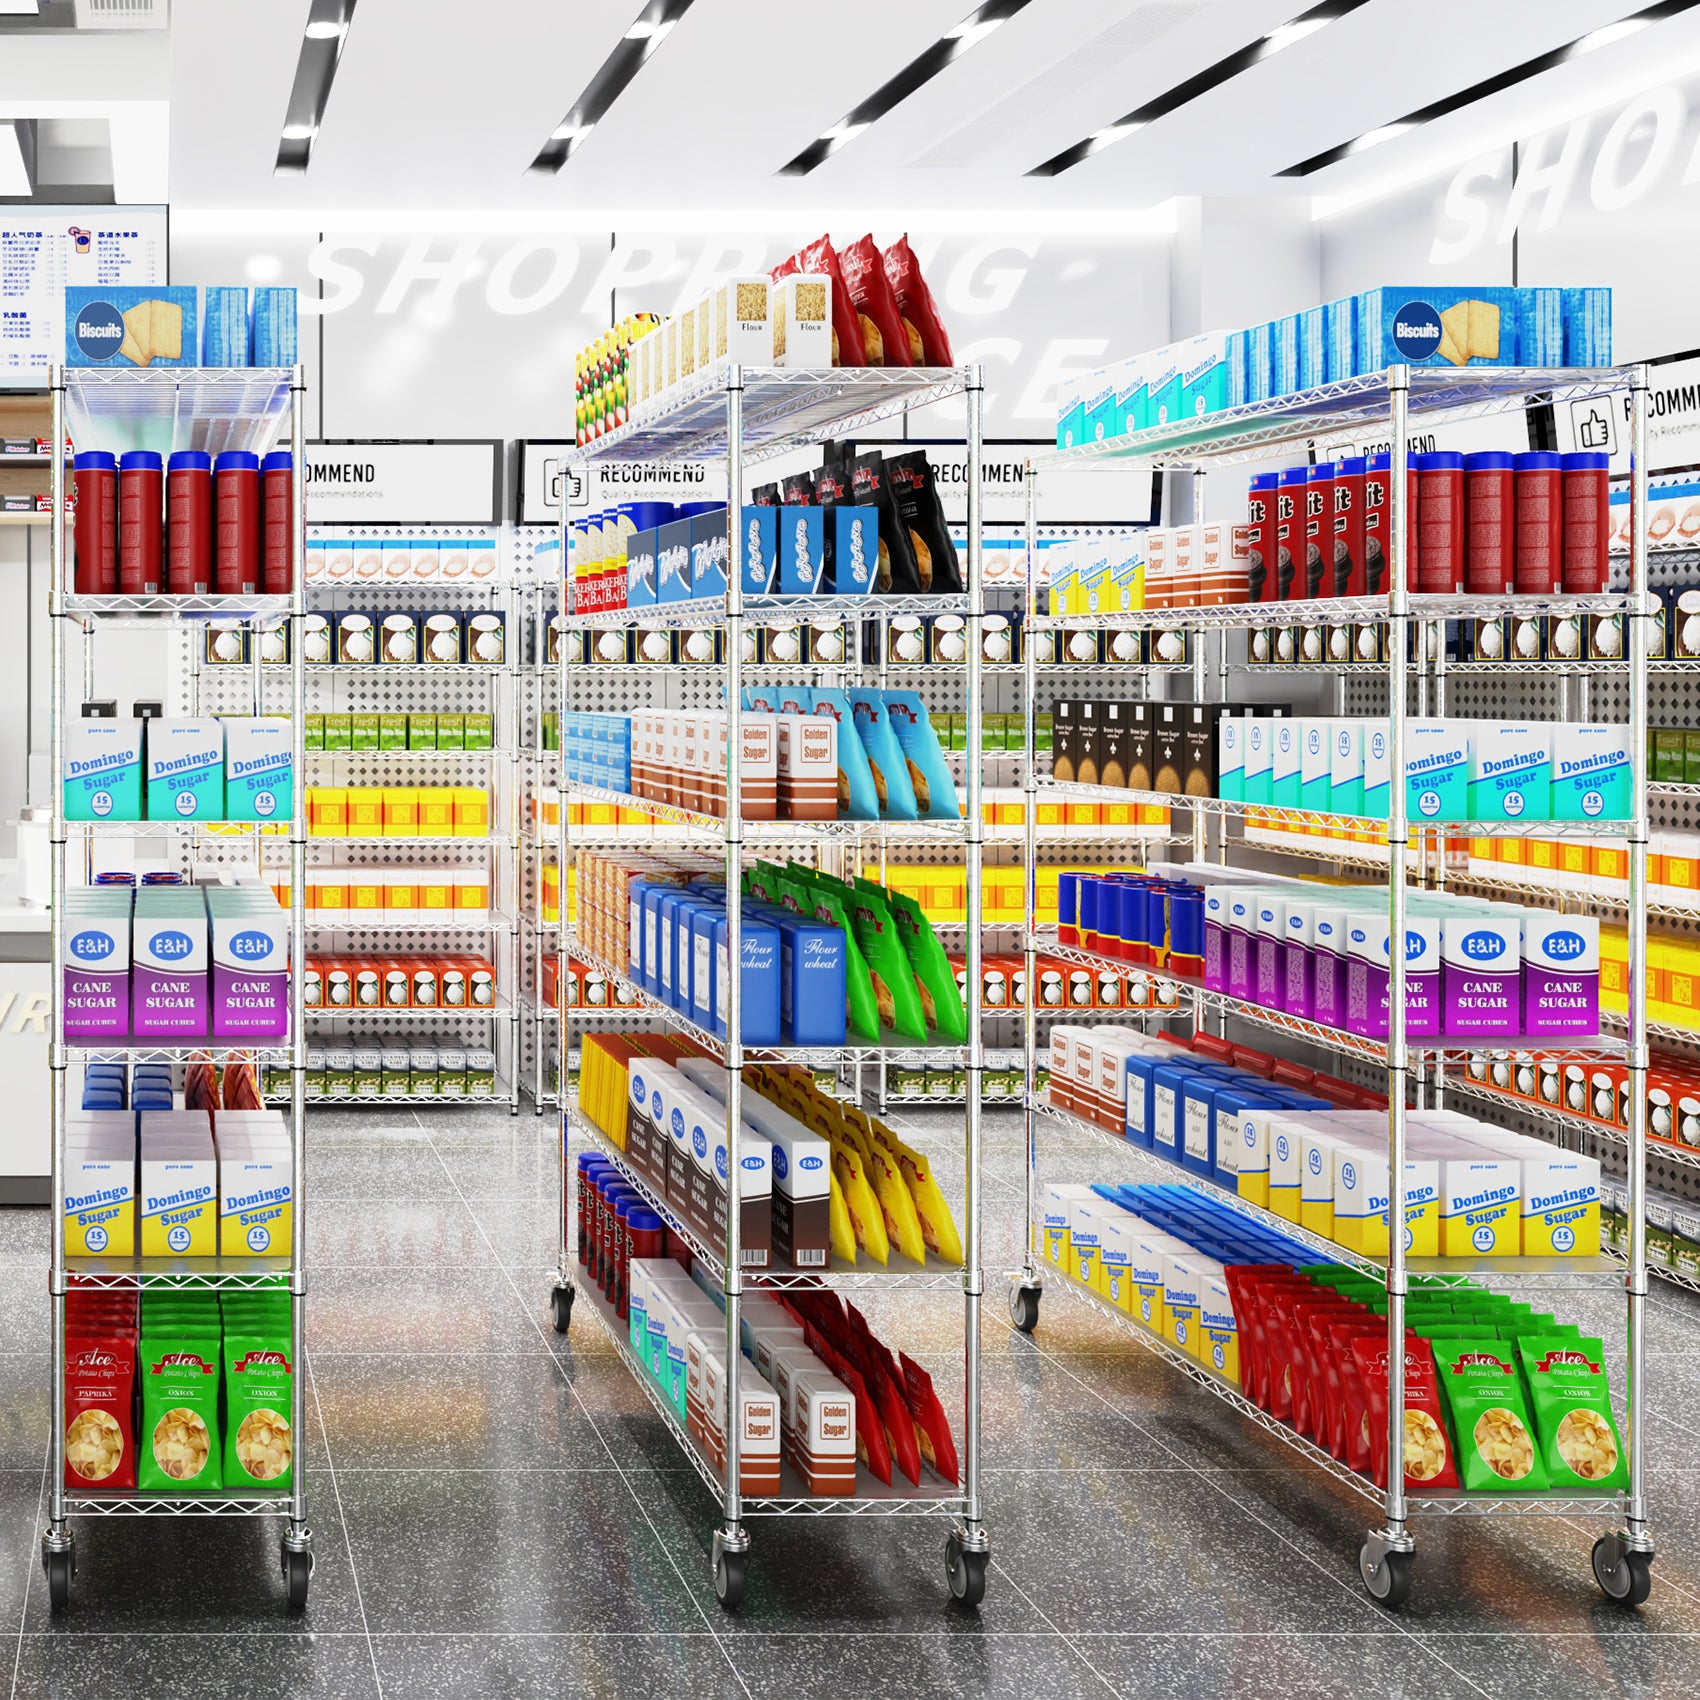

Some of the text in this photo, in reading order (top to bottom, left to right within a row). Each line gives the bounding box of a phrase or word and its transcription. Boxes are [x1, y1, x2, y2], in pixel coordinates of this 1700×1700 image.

[79, 322, 122, 338] Biscuits
[1396, 322, 1440, 338] Biscuits
[1185, 354, 1216, 382] Domingo
[1150, 366, 1176, 392] Domingo
[1192, 374, 1212, 395] Sugar
[600, 464, 704, 482] RECOMMEND
[381, 718, 404, 726] Fresh
[411, 718, 436, 726] Fresh
[466, 718, 490, 726] Fresh
[743, 729, 767, 740] Golden
[804, 729, 828, 740] Golden
[743, 746, 767, 758] Sugar
[804, 746, 828, 758] Sugar
[70, 750, 134, 774] Domingo
[154, 750, 218, 774] Domingo
[1406, 750, 1462, 774] omingo
[1482, 750, 1545, 774] Domingo
[1560, 750, 1625, 774] Domingo
[84, 772, 126, 790] Sugar
[168, 772, 210, 790] Sugar
[246, 772, 288, 790] Sugar
[1411, 772, 1454, 790] Sugar
[1496, 772, 1537, 790] Sugar
[1574, 772, 1616, 790] Sugar
[97, 796, 108, 804] 15
[180, 796, 192, 804] 15
[260, 796, 270, 804] 15
[1424, 796, 1435, 804] 15
[1508, 796, 1520, 804] 15
[1587, 796, 1598, 804] 15
[77, 938, 109, 954] E&H
[156, 938, 188, 954] E&H
[236, 938, 268, 954] E&H
[804, 938, 838, 954] Flour
[1468, 938, 1500, 954] E&H
[1549, 938, 1580, 954] E&H
[804, 956, 837, 968] wheat
[72, 982, 111, 993] CANE
[151, 982, 190, 993] CANE
[231, 982, 270, 993] CANE
[1463, 982, 1503, 993] CANE
[1544, 982, 1582, 993] CANE
[68, 997, 116, 1008] SUGAR
[146, 997, 195, 1008] SUGAR
[226, 997, 276, 1008] SUGAR
[1458, 997, 1508, 1008] SUGAR
[1538, 997, 1588, 1008] SUGAR
[1185, 1099, 1208, 1119] Flour
[66, 1186, 128, 1210] Domingo
[147, 1186, 211, 1210] Domingo
[226, 1186, 290, 1210] Domingo
[1452, 1186, 1515, 1210] Domingo
[1531, 1186, 1595, 1210] Domingo
[78, 1207, 120, 1226] Sugar
[161, 1207, 202, 1226] Sugar
[240, 1207, 282, 1226] Sugar
[1465, 1207, 1507, 1226] Sugar
[1544, 1207, 1587, 1226] Sugar
[90, 1231, 102, 1239] 15
[174, 1231, 185, 1239] 15
[252, 1231, 264, 1239] 15
[1478, 1231, 1489, 1239] 15
[1557, 1231, 1569, 1239] 15
[1134, 1268, 1159, 1281] Domingo
[1139, 1286, 1156, 1298] Sugar
[1166, 1289, 1196, 1303] Domingo
[1172, 1307, 1192, 1320] Sugar
[1203, 1311, 1235, 1327] Domingo
[1209, 1330, 1231, 1344] Sugar
[98, 1369, 114, 1379] Chips
[184, 1369, 200, 1379] Chips
[267, 1369, 284, 1379] Chips
[1487, 1369, 1503, 1379] Chips
[1573, 1369, 1590, 1379] Chips
[748, 1407, 771, 1417] Golden
[824, 1407, 846, 1417] Golden
[748, 1424, 771, 1436] Sugar
[824, 1424, 846, 1436] Sugar
